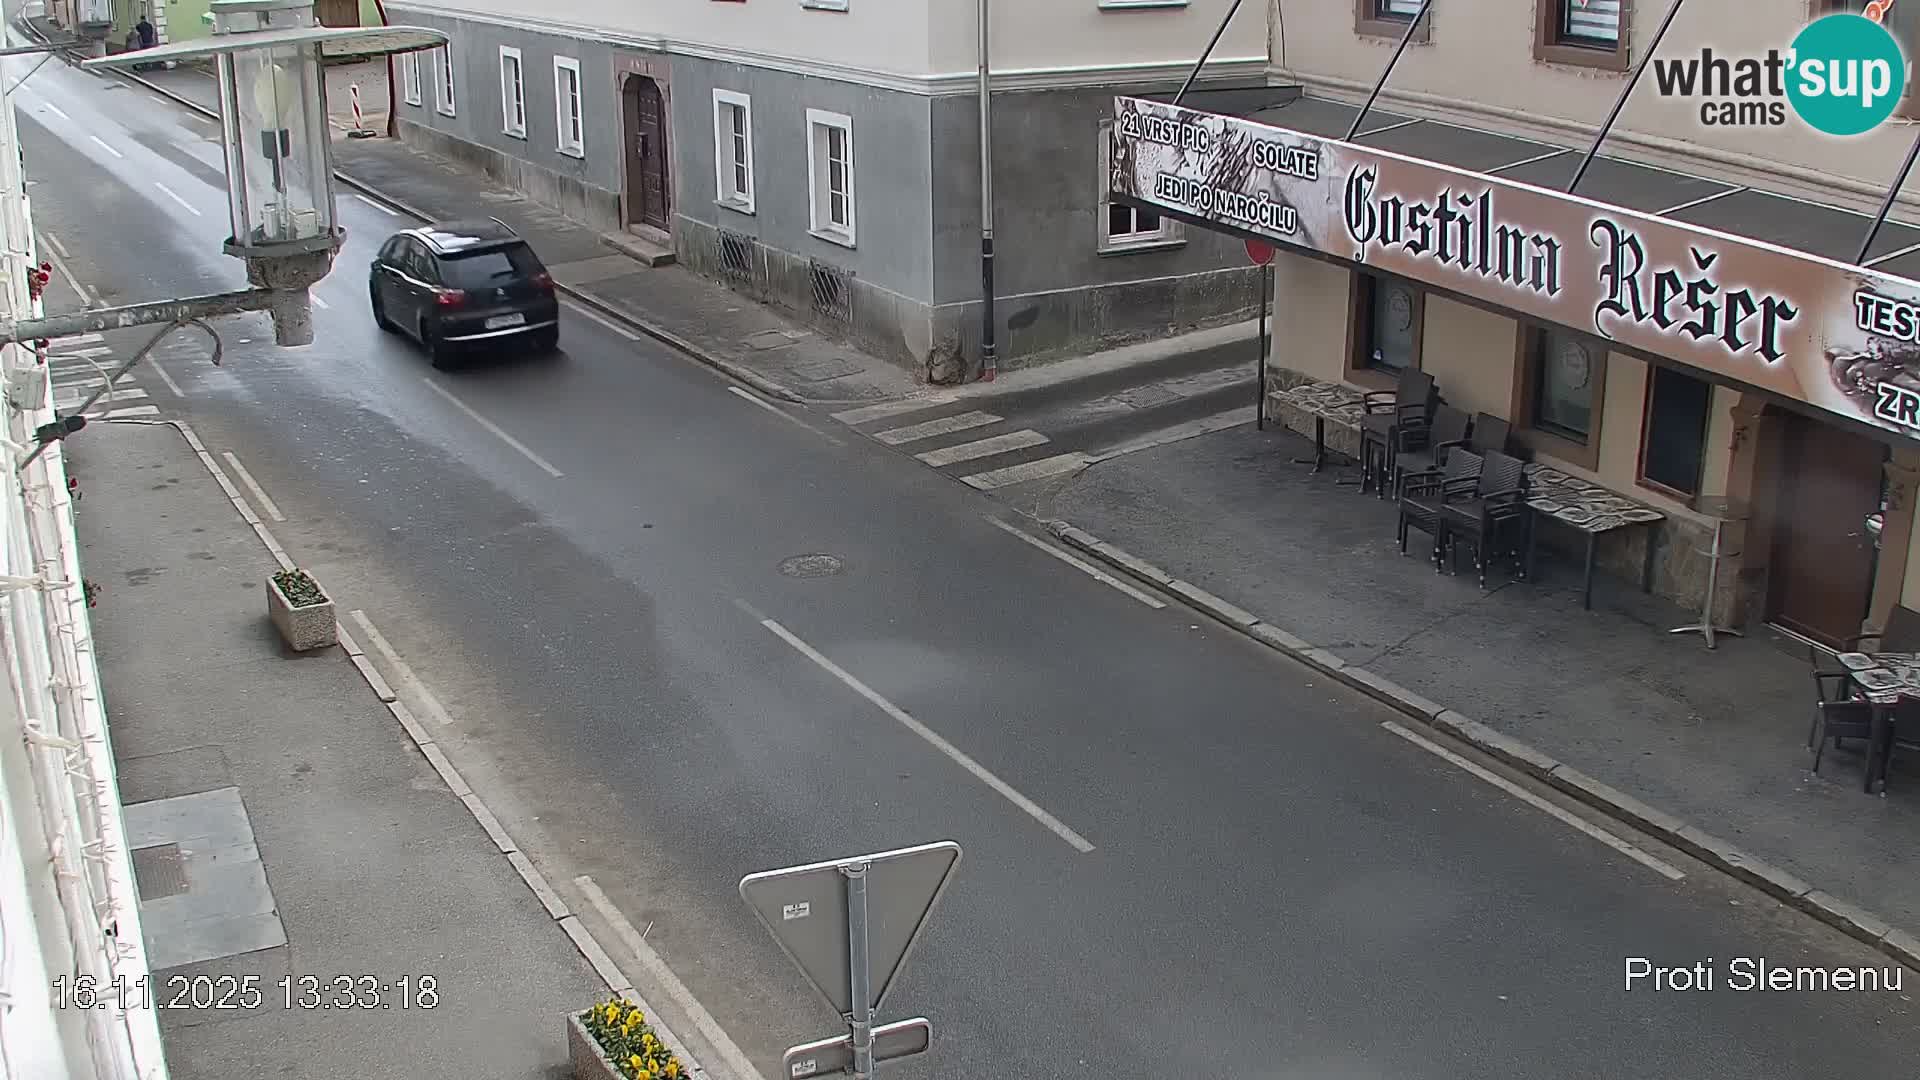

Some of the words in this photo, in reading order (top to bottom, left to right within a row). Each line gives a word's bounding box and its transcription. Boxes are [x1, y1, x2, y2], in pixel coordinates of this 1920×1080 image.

[1122, 113, 1140, 136] 21
[1142, 116, 1181, 148] VRST
[1182, 125, 1209, 151] PIC
[1253, 141, 1318, 179] SOLATE
[1156, 174, 1186, 201] JEDI
[1190, 182, 1212, 209] PO
[1215, 189, 1296, 233] NAROČILU
[1344, 163, 1562, 297] Gostilna
[1590, 218, 1799, 363] Rešer
